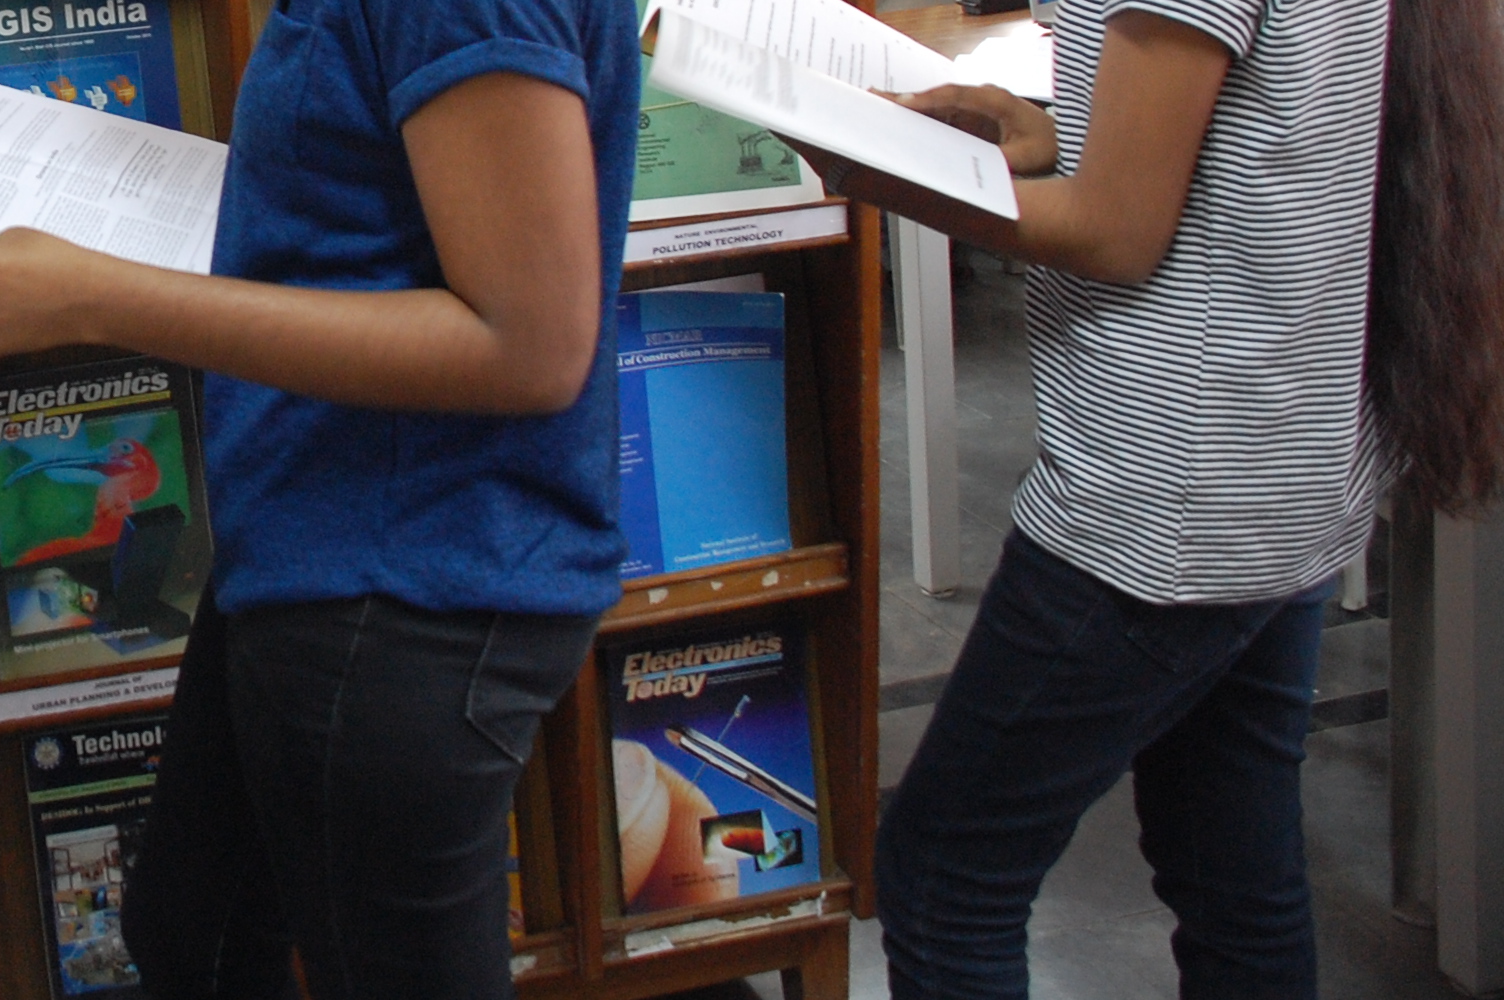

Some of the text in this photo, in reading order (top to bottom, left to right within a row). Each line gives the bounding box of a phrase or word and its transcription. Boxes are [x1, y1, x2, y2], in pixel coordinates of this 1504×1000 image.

[653, 230, 785, 254] POLLUTION TECHNOLOGY
[624, 354, 635, 366] of
[636, 348, 701, 362] Construction
[703, 346, 771, 356] Management
[624, 636, 783, 677] Electronics
[626, 672, 707, 702] Today
[32, 700, 66, 711] URBAN
[70, 691, 121, 704] PLANNING
